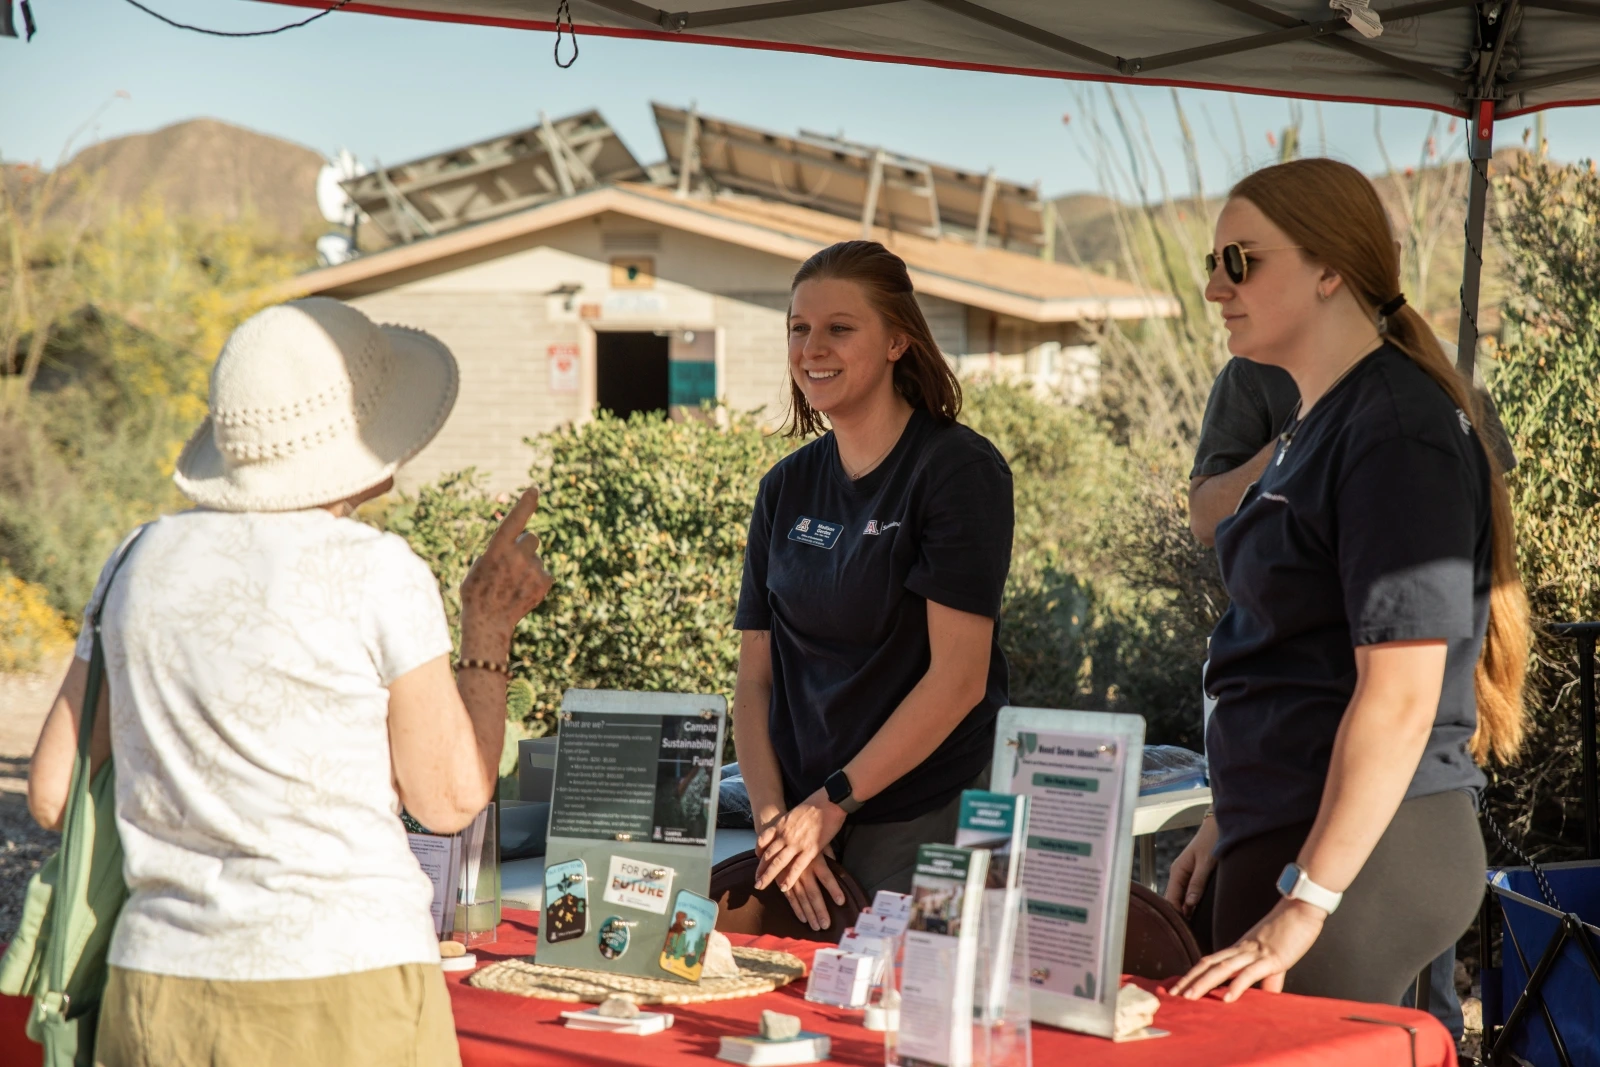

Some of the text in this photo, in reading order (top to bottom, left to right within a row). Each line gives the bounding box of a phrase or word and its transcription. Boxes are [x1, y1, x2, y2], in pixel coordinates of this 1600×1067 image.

[863, 520, 879, 535] A
[581, 721, 591, 729] are
[592, 720, 605, 729] we?
[684, 721, 717, 734] Campus
[662, 737, 717, 752] Sustainability
[692, 755, 714, 767] Fund
[621, 863, 640, 876] FOR
[612, 876, 664, 898] FUTURE
